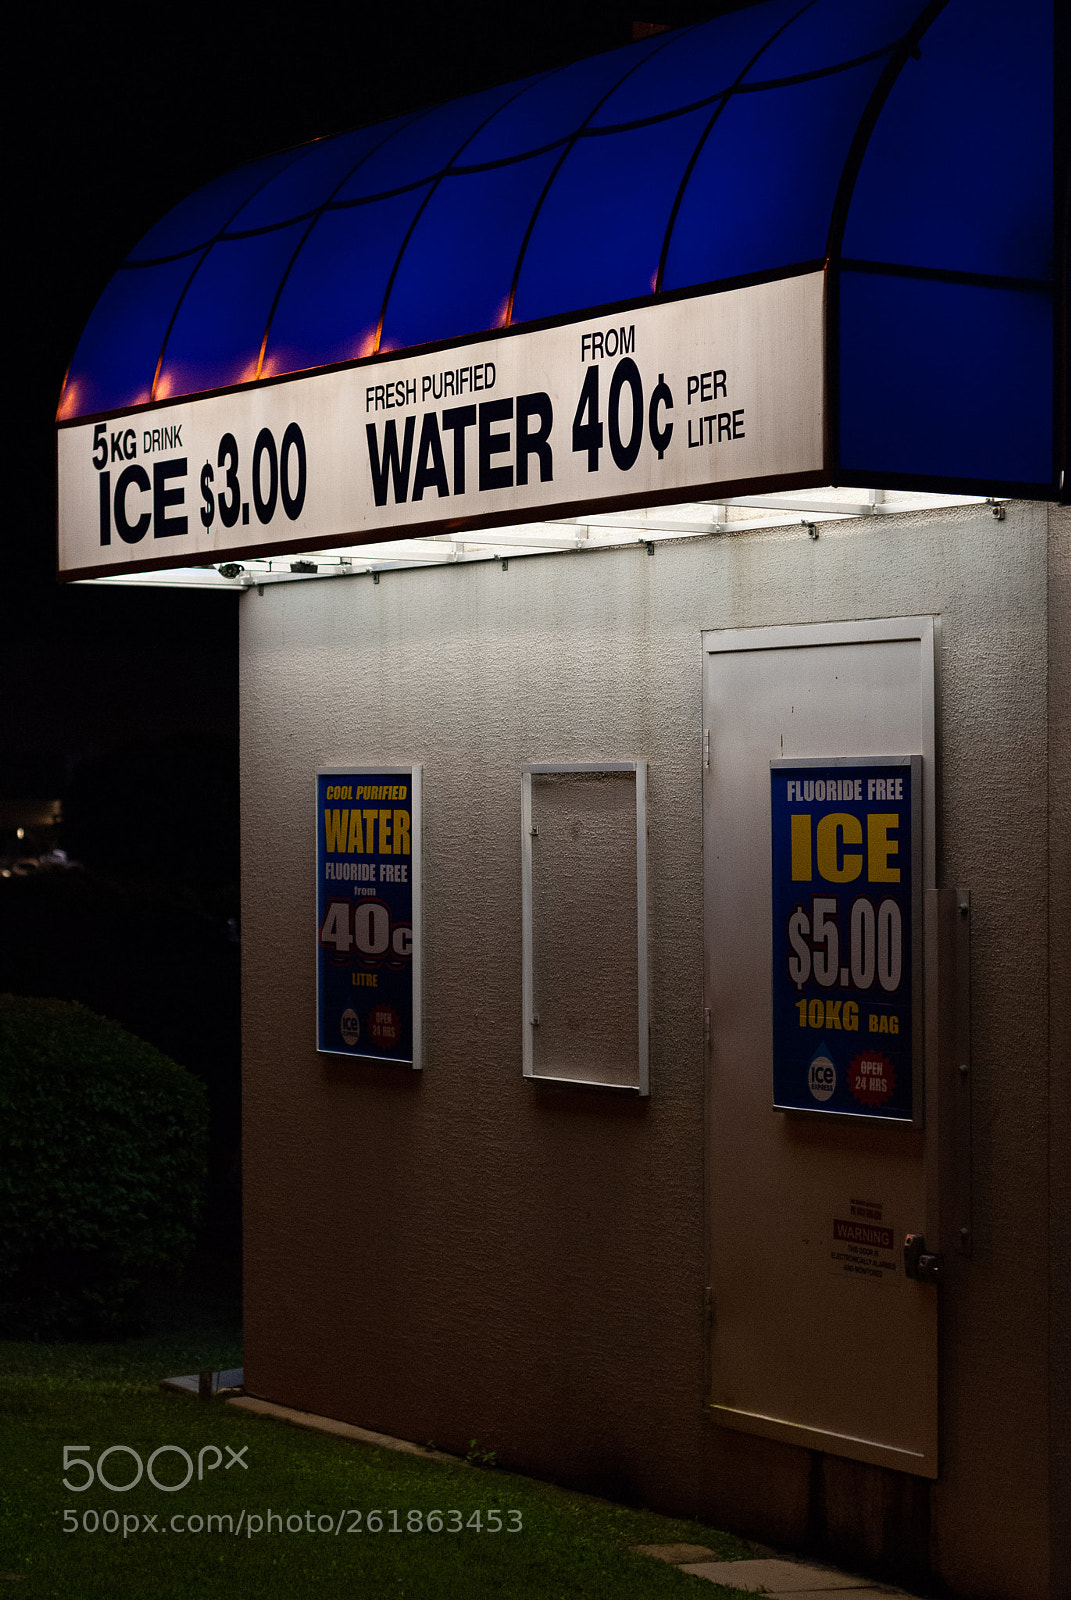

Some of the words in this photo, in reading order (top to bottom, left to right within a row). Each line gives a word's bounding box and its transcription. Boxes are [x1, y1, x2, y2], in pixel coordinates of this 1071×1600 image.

[581, 325, 635, 362] FROM
[366, 378, 416, 413] FRESH
[422, 362, 496, 401] PURIFIED
[687, 370, 727, 405] PER
[92, 423, 137, 471] 5KG
[143, 424, 183, 454] DRINK
[688, 409, 745, 448] LITRE
[366, 391, 554, 507] WATER
[99, 457, 188, 546] ICE
[200, 422, 307, 534] $3.00
[326, 785, 353, 800] COOL
[355, 785, 408, 801] PURIFIED
[786, 778, 863, 802] FLUORIDE
[867, 778, 903, 801] FREE
[324, 809, 411, 855] WATER
[790, 812, 901, 883] ICE
[325, 862, 376, 882] FLUORIDE
[379, 864, 408, 883] FREE
[354, 886, 376, 896] from
[787, 897, 902, 992] $5.00
[352, 972, 378, 987] LITRE
[794, 998, 859, 1031] 10KG
[868, 1014, 899, 1035] BAG
[855, 1076, 866, 1090] 24
[869, 1077, 887, 1092] HRS
[861, 1061, 883, 1076] OPEN
[838, 1223, 890, 1246] WARNING
